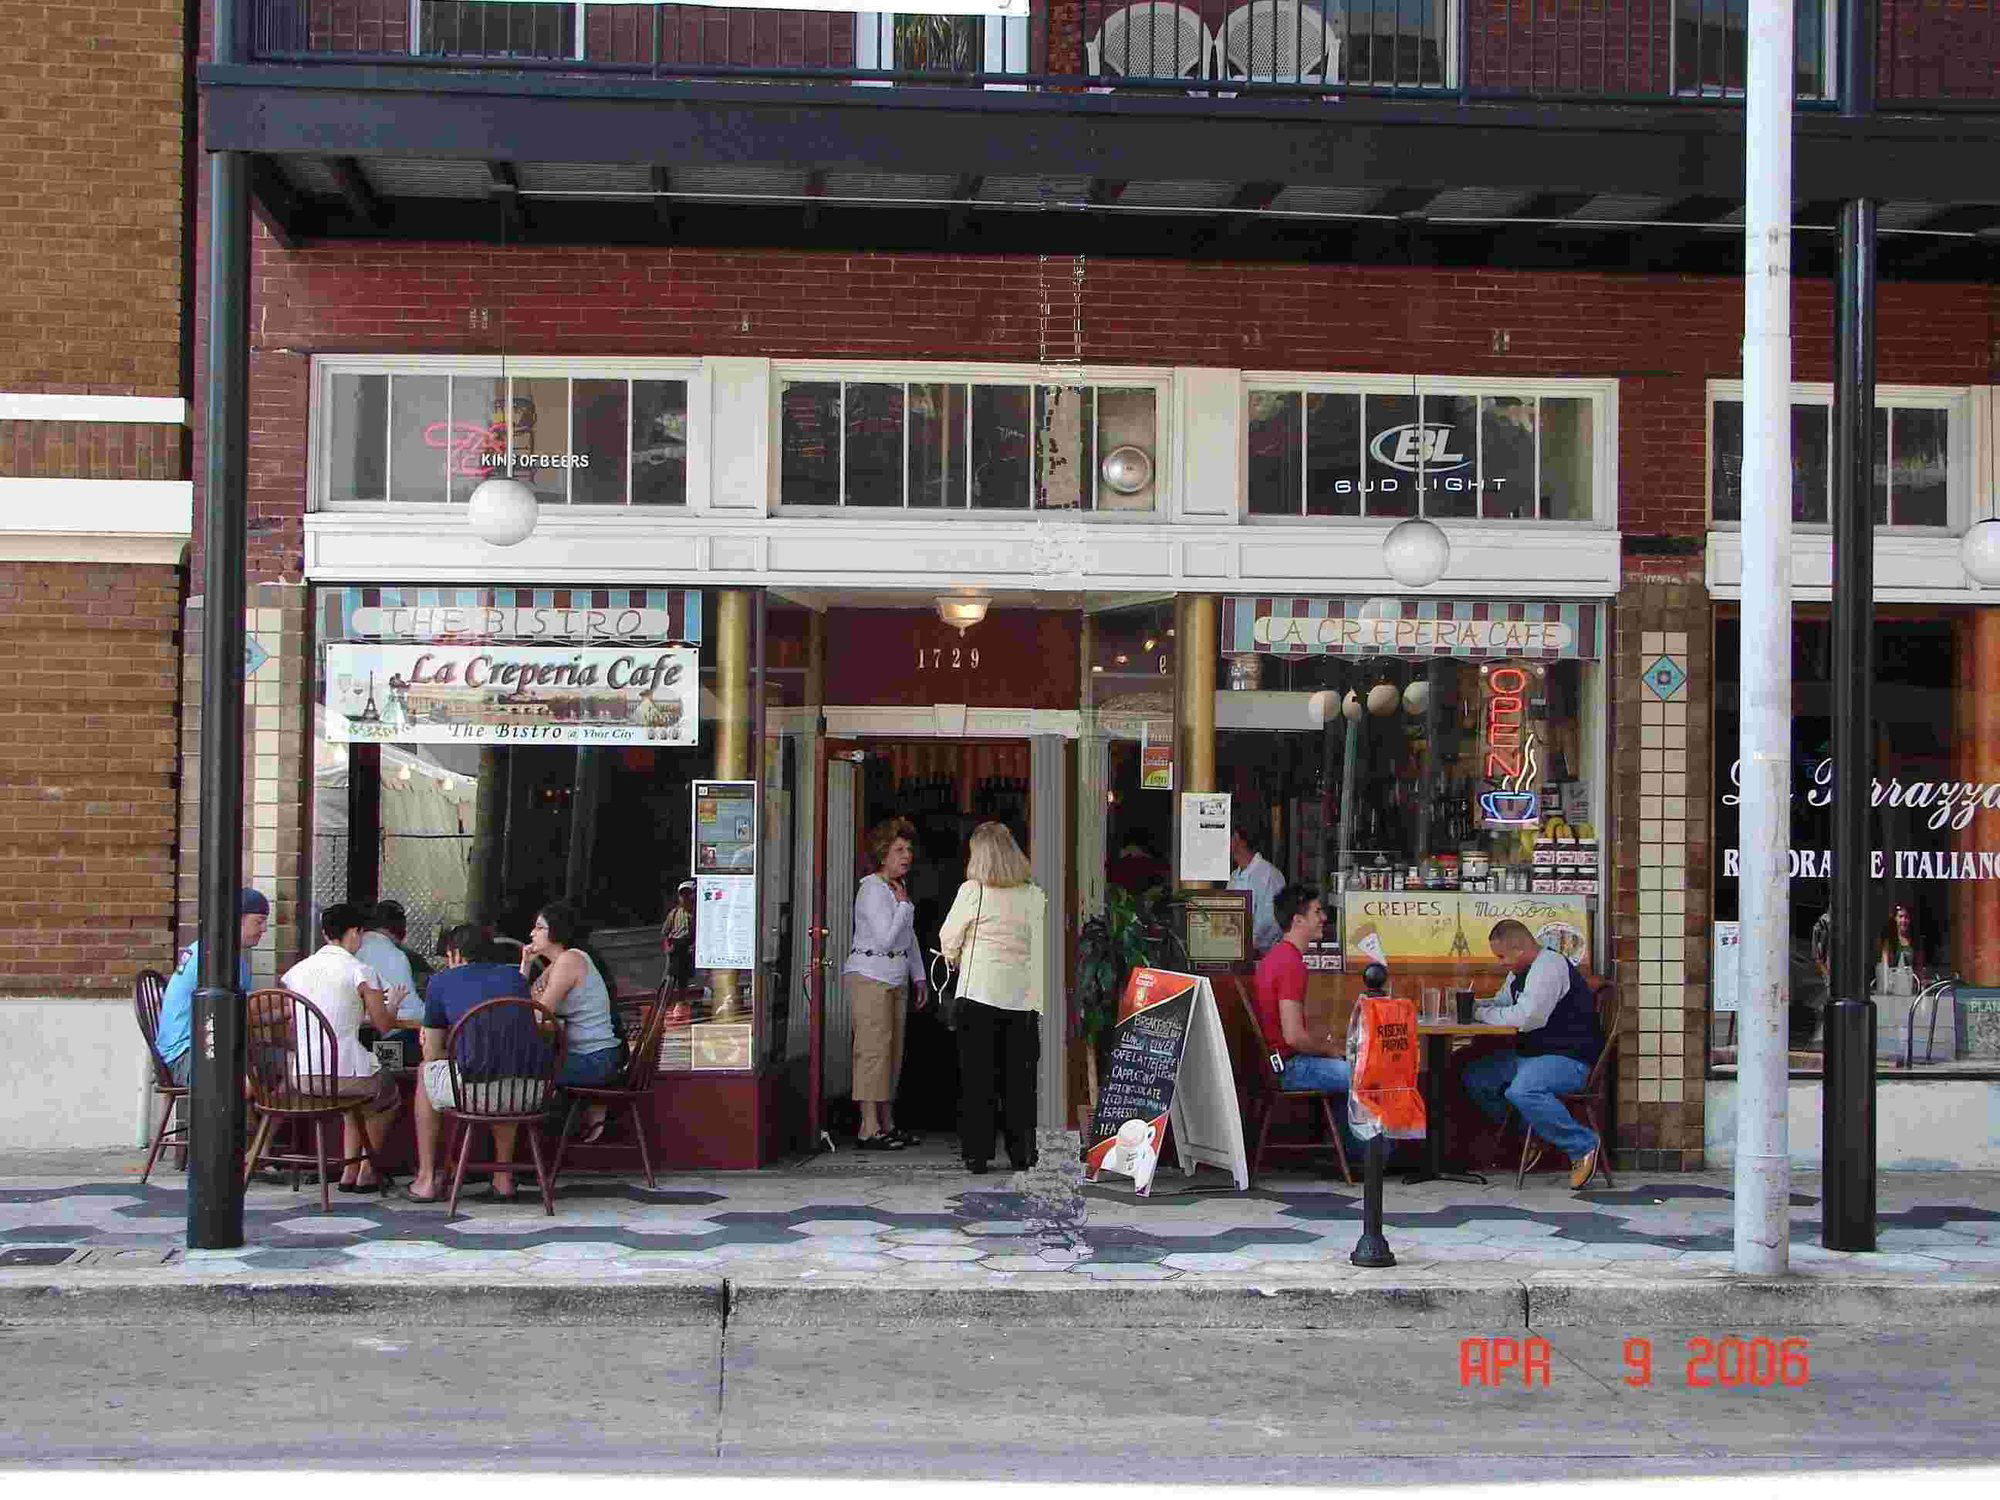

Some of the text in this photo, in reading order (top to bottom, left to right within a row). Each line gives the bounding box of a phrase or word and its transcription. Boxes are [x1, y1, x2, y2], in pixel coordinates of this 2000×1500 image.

[1394, 429, 1464, 463] BL
[519, 454, 538, 467] OF
[540, 454, 589, 468] BEERS
[1334, 477, 1507, 493] BUD LIGHT
[381, 607, 643, 636] THE BISTRO
[1264, 619, 1561, 648] LA CREPERIA CAFE
[919, 647, 980, 669] 1729
[408, 653, 684, 698] La Creperia Cafe
[449, 722, 486, 738] The
[494, 722, 562, 739] Bistro
[612, 728, 636, 741] City
[1486, 667, 1527, 778] OPEN
[1723, 849, 1886, 879] RORAE
[1363, 900, 1443, 918] CREPES
